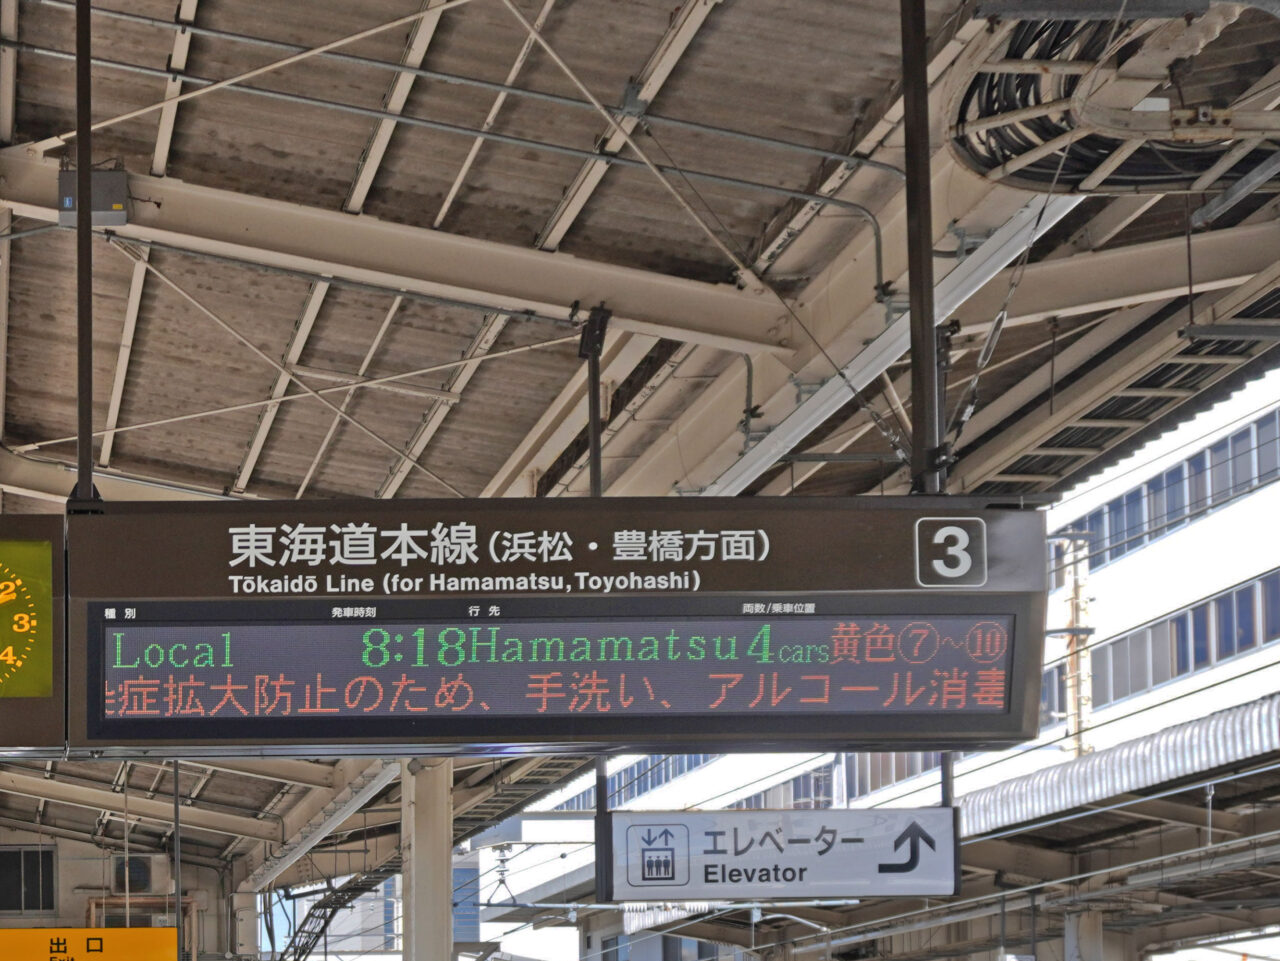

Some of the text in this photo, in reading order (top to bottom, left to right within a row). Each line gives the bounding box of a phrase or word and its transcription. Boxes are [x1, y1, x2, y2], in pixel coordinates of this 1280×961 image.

[932, 527, 972, 577] 3
[229, 575, 318, 594] Tōkaidō
[326, 574, 375, 594] Line
[382, 572, 424, 595] (for
[12, 613, 31, 632] 3
[113, 632, 234, 668] Local
[361, 627, 466, 667] 8:18
[468, 626, 738, 663] Hamamatsu
[703, 825, 865, 857] エレベーター
[703, 864, 808, 884] Elevator
